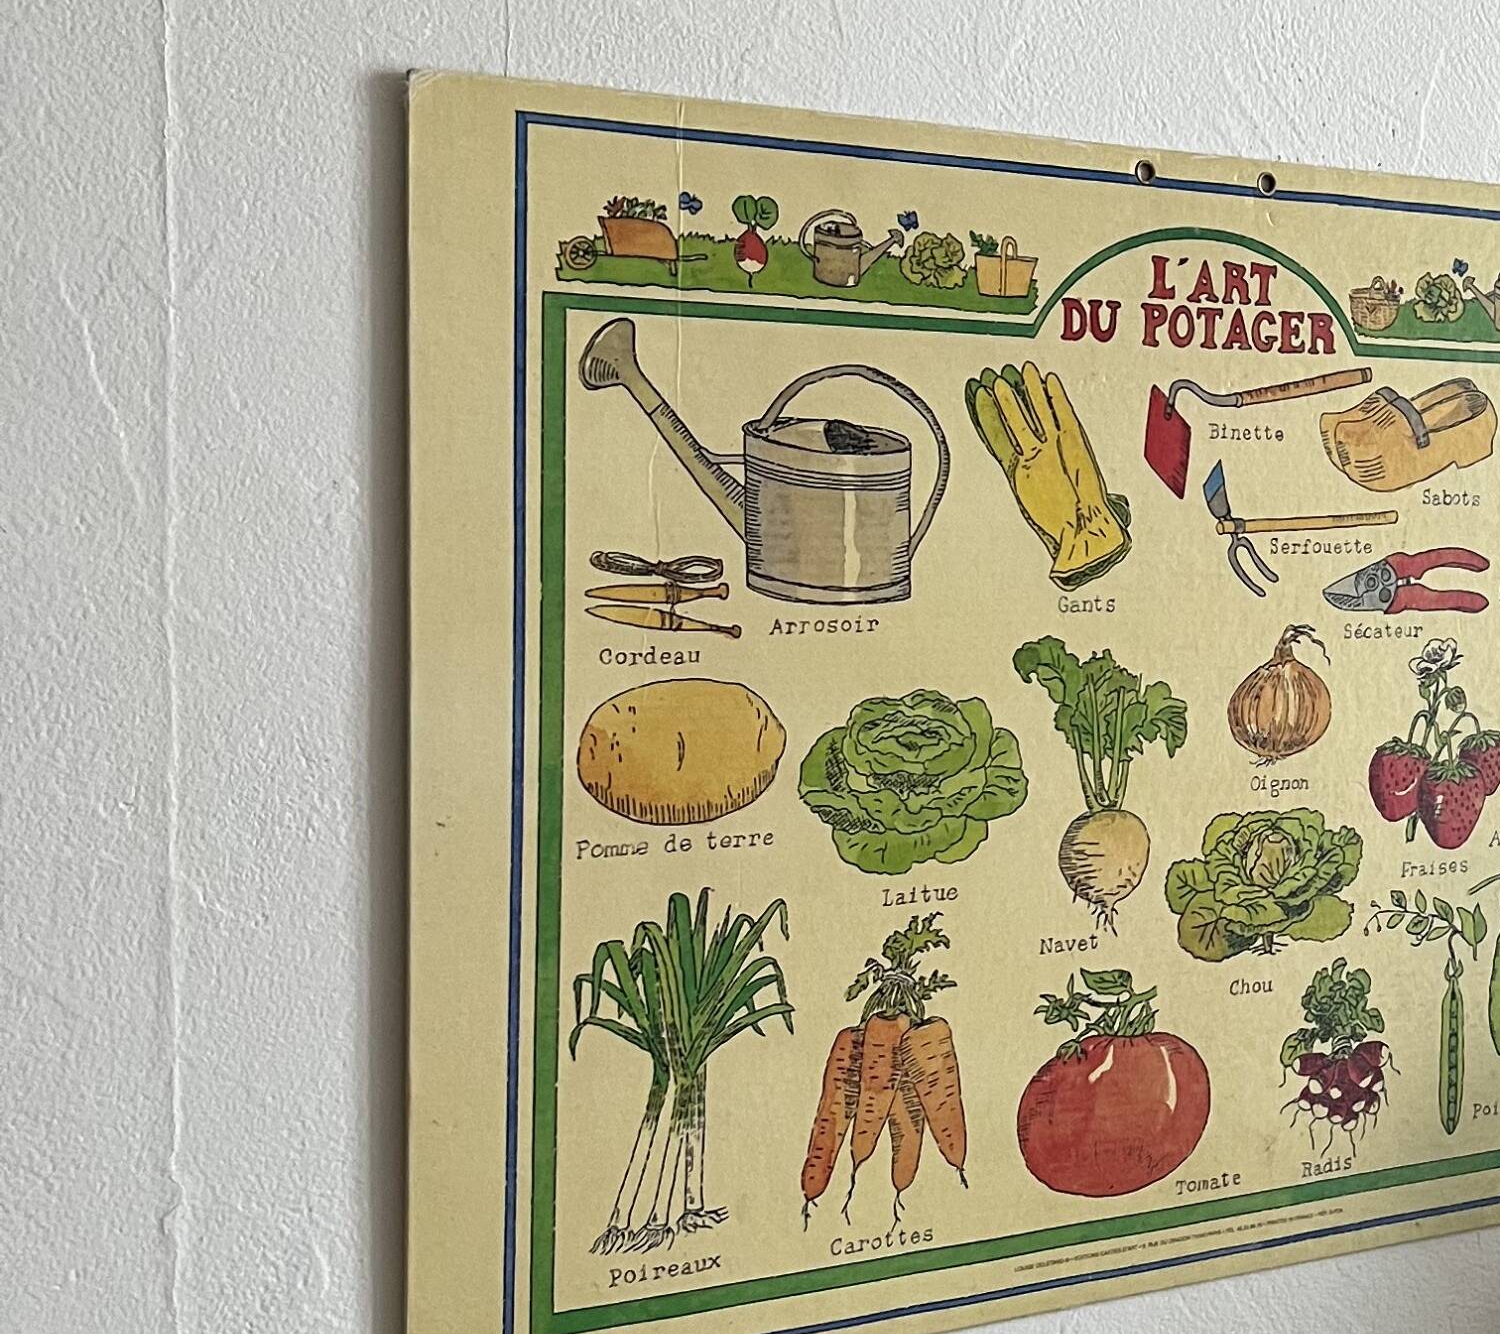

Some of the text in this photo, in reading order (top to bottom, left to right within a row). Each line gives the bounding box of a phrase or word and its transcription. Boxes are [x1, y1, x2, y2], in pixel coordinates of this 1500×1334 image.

[1150, 254, 1277, 306] L'ART
[1061, 297, 1337, 356] DU POTAGER
[1208, 423, 1285, 443] Binette
[1422, 487, 1481, 508] Sabots
[1269, 537, 1373, 557] Serfouette
[1057, 594, 1117, 615] Gants
[768, 616, 880, 636] Arrosoir
[1343, 620, 1424, 641] Sécateur
[599, 647, 701, 666] Cordeau
[1250, 775, 1310, 797] Oignon
[575, 830, 775, 860] Pomme de terre
[1401, 859, 1469, 879] Fraises
[881, 885, 959, 907] Laitue
[1039, 935, 1099, 955] Navet
[1229, 978, 1274, 996] Chou
[1301, 1156, 1353, 1179] Radis
[1175, 1171, 1241, 1195] Tomate
[829, 1227, 935, 1257] Carottes
[608, 1252, 722, 1288] Poireaux
